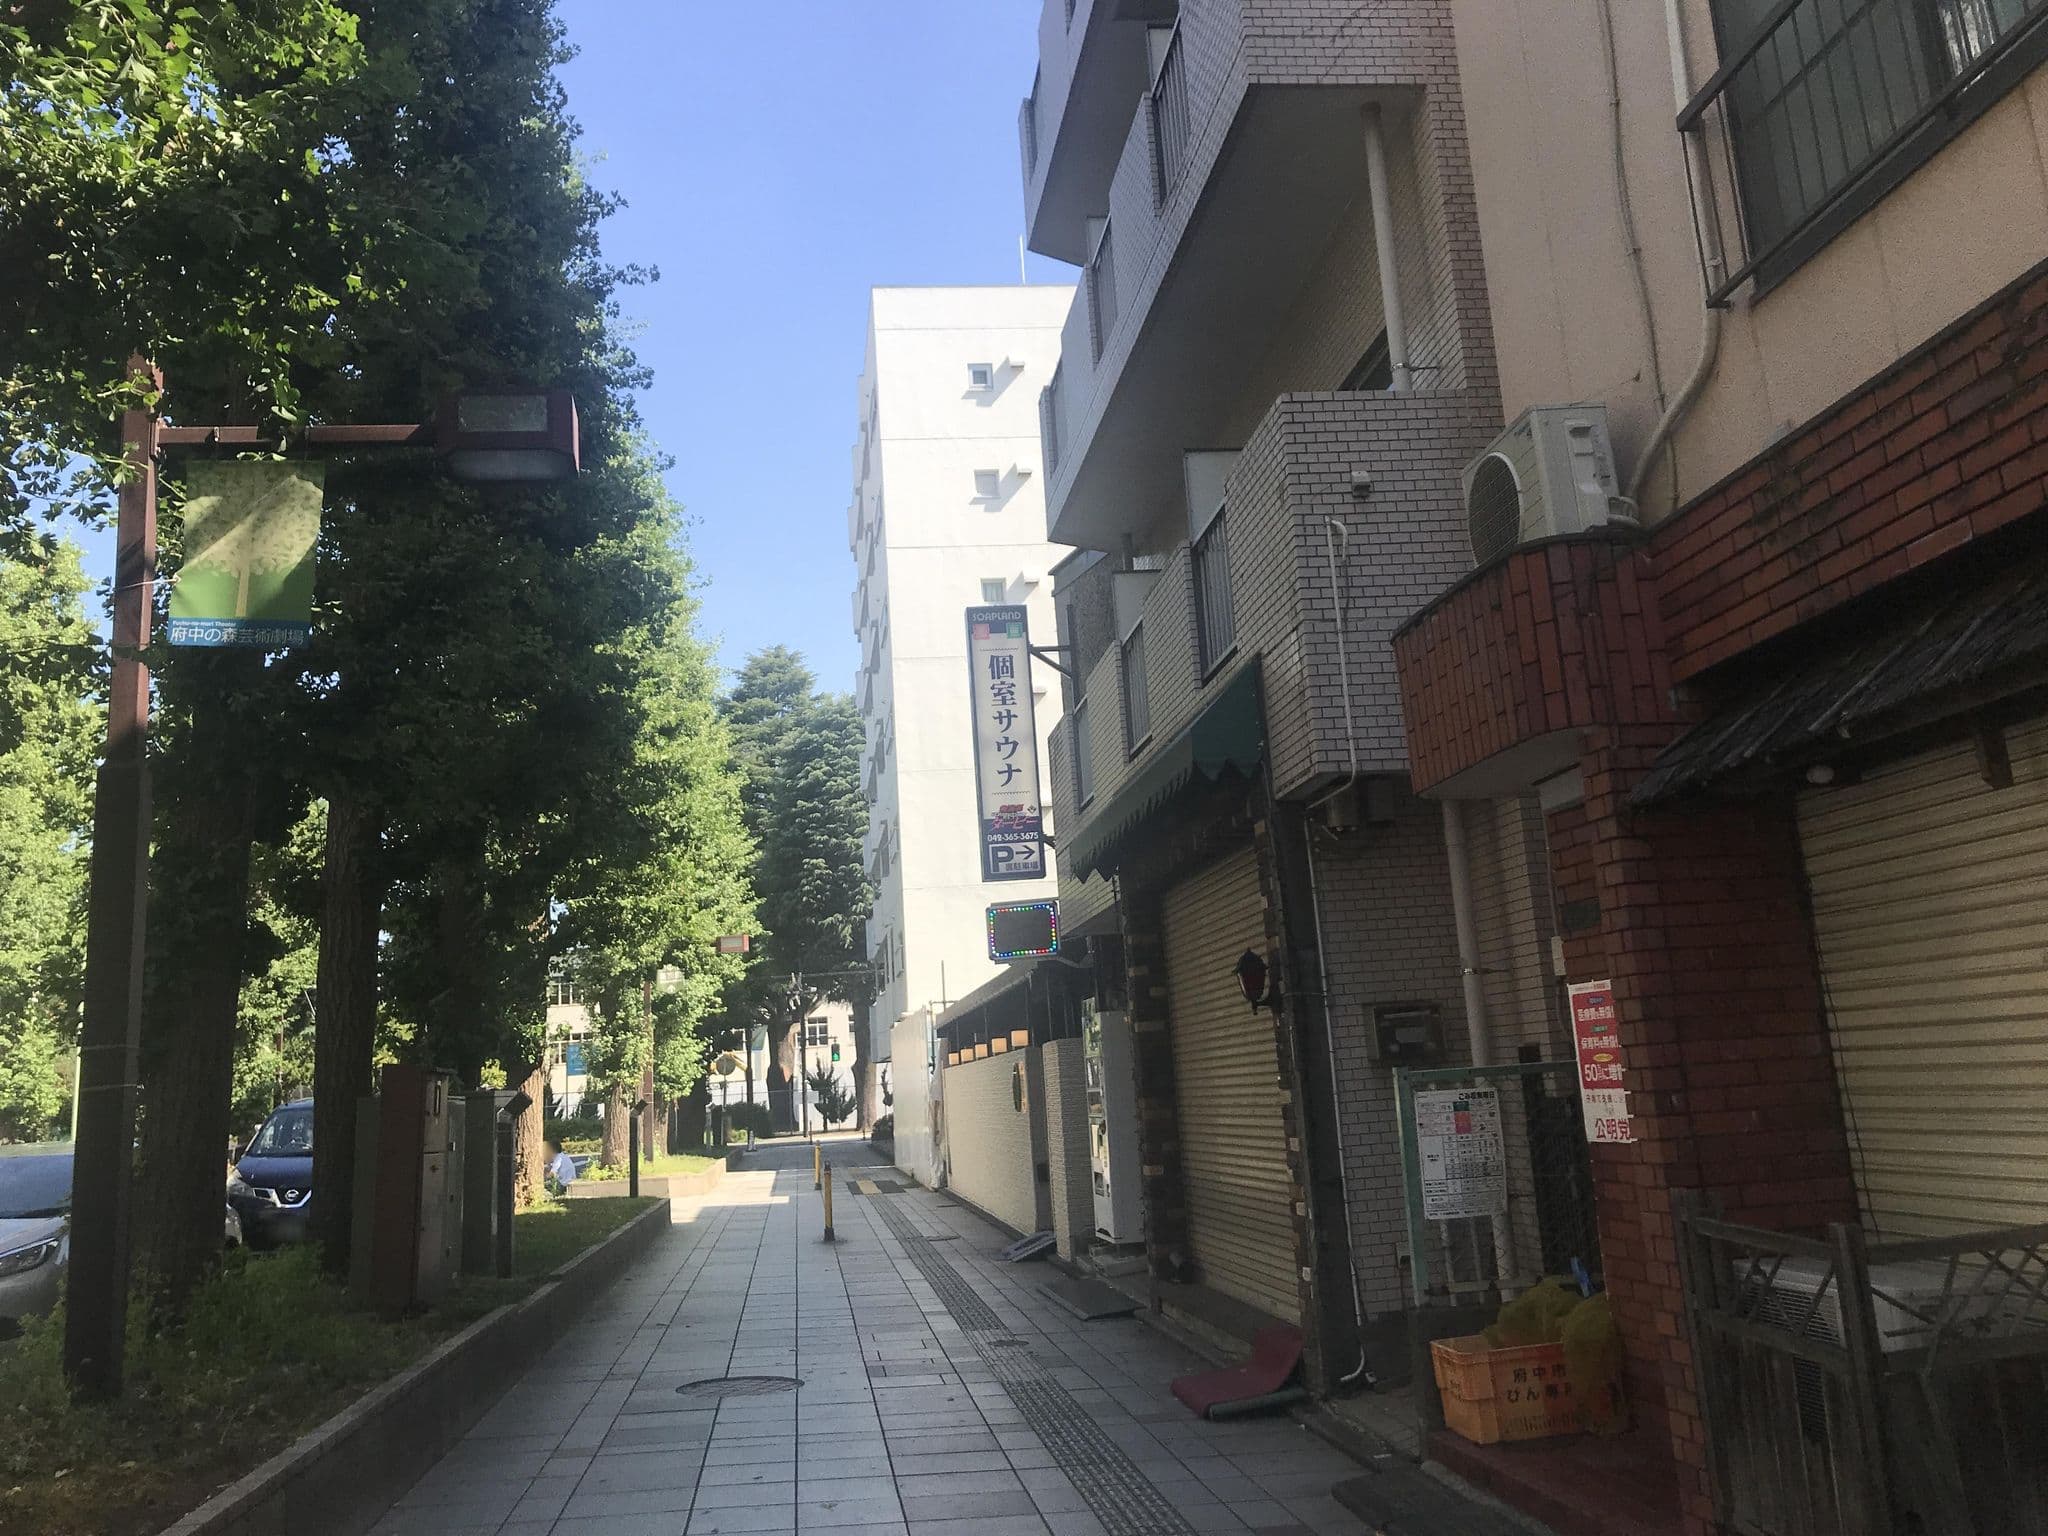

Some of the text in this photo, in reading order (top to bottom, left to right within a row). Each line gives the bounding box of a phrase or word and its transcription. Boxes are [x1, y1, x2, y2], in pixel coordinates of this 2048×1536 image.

[972, 611, 1022, 621] SOAPLAND
[170, 626, 305, 645] 府中の森芸術劇場
[988, 654, 1023, 788] 個室サウナ
[991, 846, 1014, 872] P
[1595, 1118, 1631, 1140] 公明党
